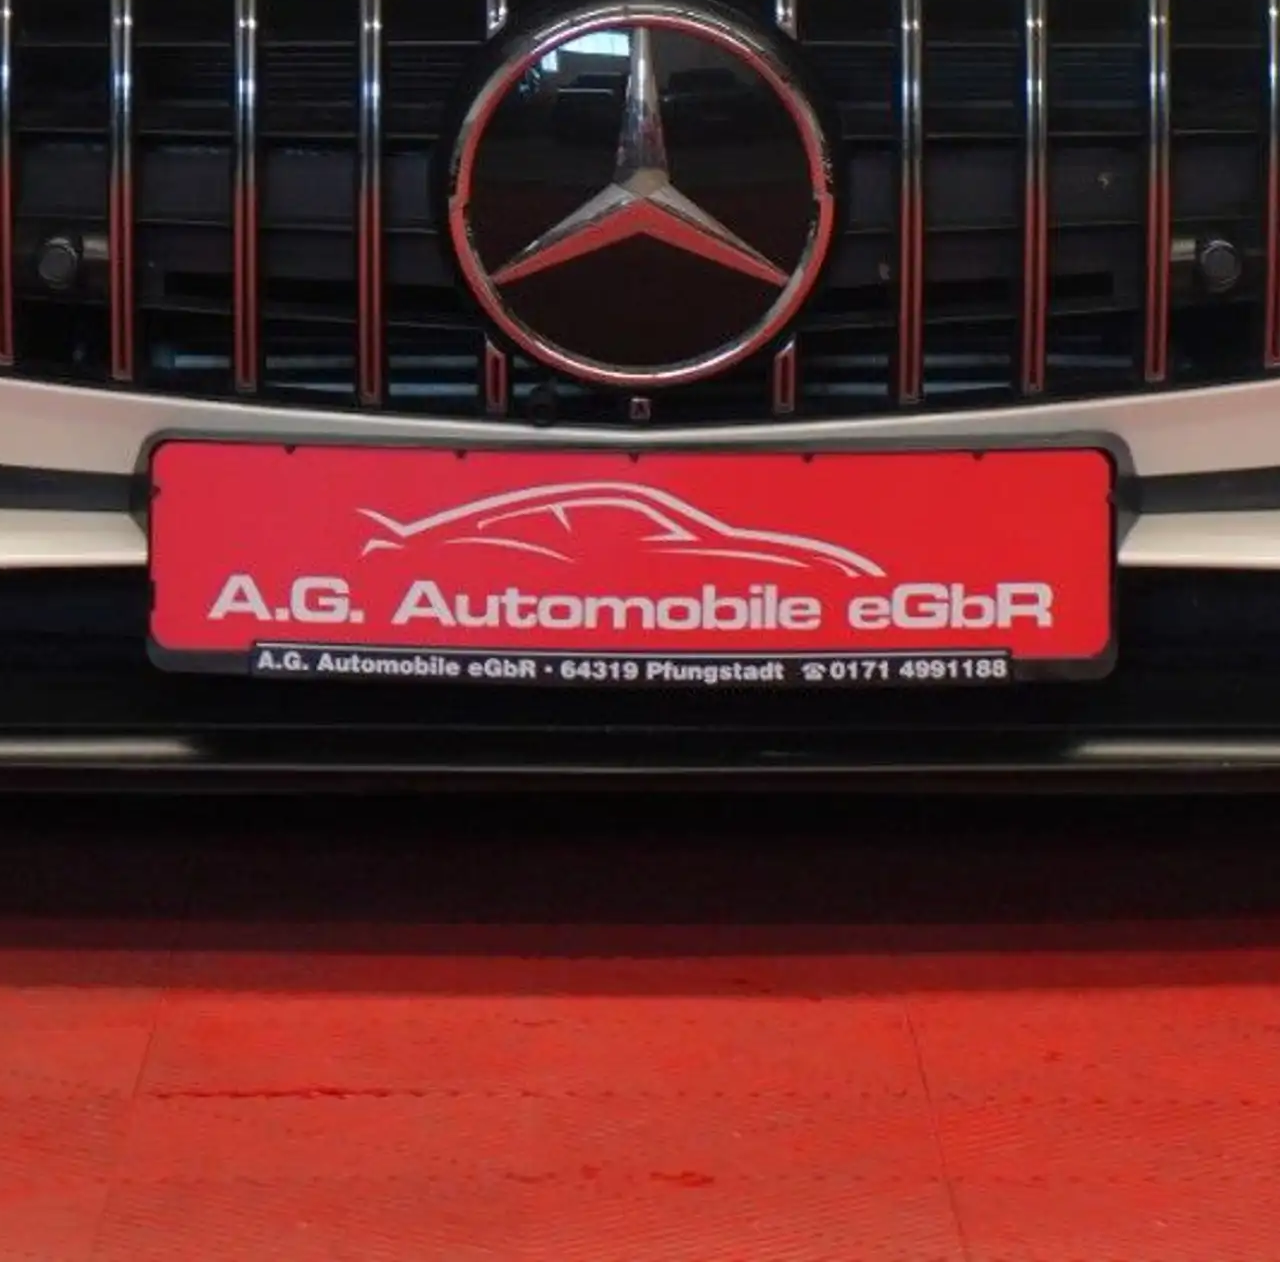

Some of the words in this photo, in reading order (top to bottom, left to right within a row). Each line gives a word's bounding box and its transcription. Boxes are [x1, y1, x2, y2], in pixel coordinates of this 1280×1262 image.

[207, 574, 366, 624] A.G.
[391, 580, 822, 630] Automobile
[848, 582, 1053, 630] eGbR
[256, 649, 309, 672] A.G.
[317, 651, 461, 677] Automobile
[467, 655, 537, 678] eGbR
[560, 658, 638, 680] 64319
[646, 659, 785, 682] Pfungstadt
[829, 659, 890, 680] 0171
[899, 658, 1008, 679] 4991188
